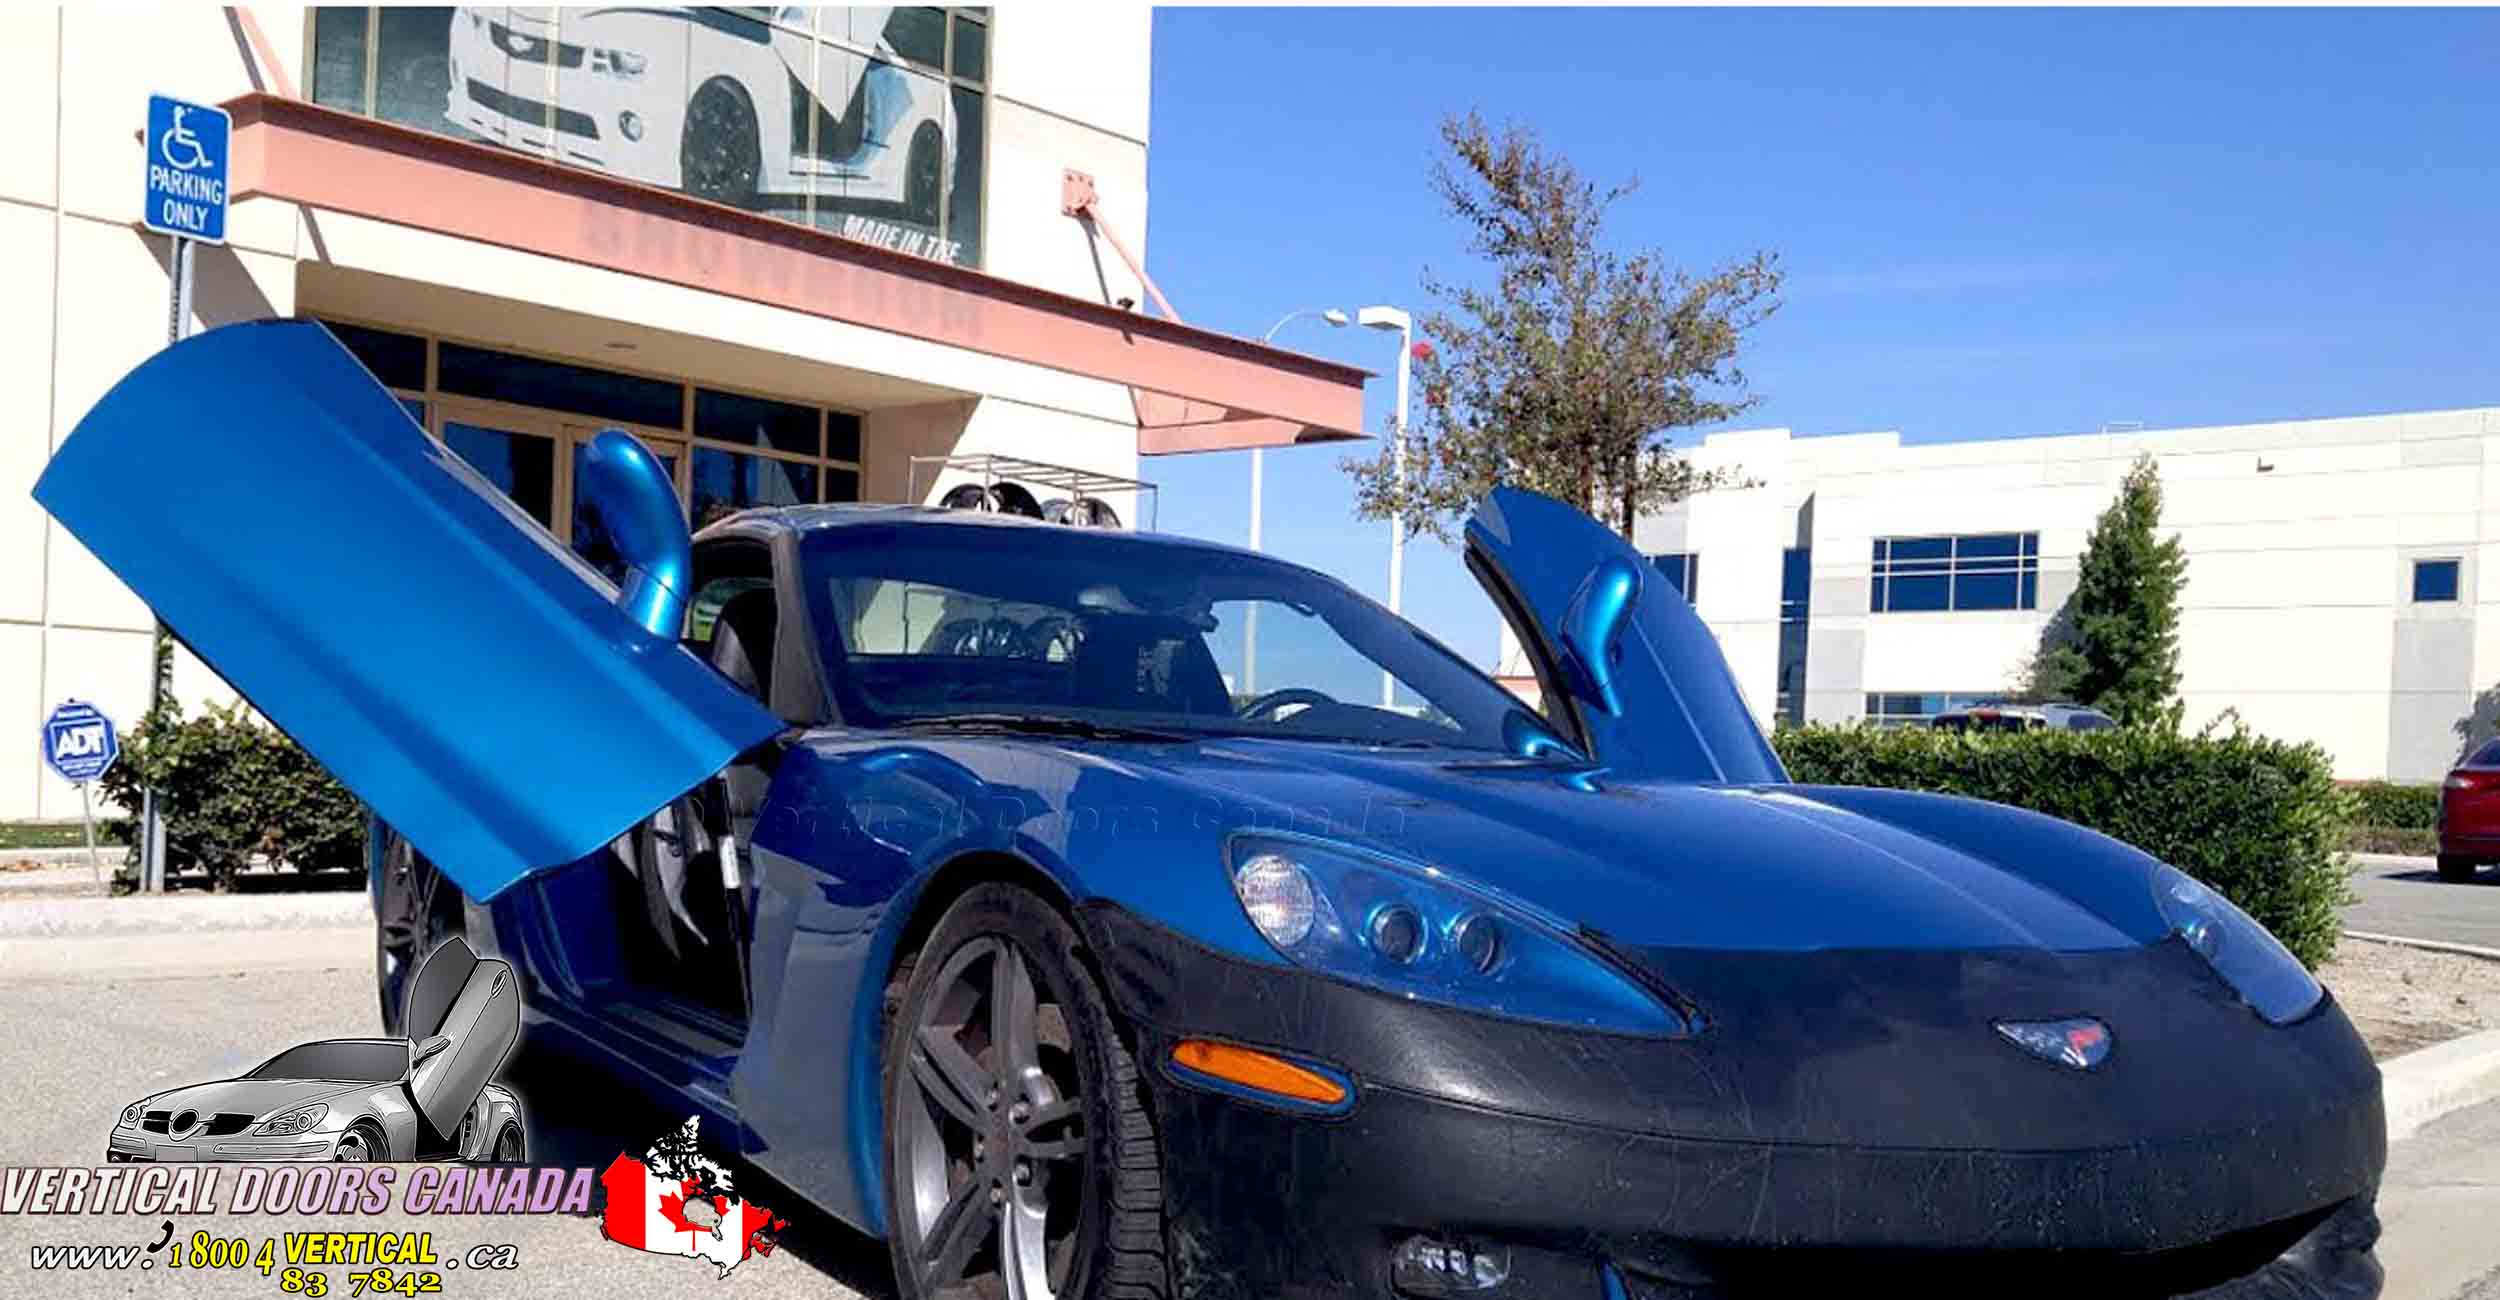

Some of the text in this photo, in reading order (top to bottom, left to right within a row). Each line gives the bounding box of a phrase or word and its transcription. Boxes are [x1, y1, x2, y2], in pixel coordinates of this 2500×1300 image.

[150, 165, 223, 206] PARKING
[162, 198, 208, 233] ONLY
[843, 214, 961, 264] MADE IN THE
[56, 726, 102, 758] ADT
